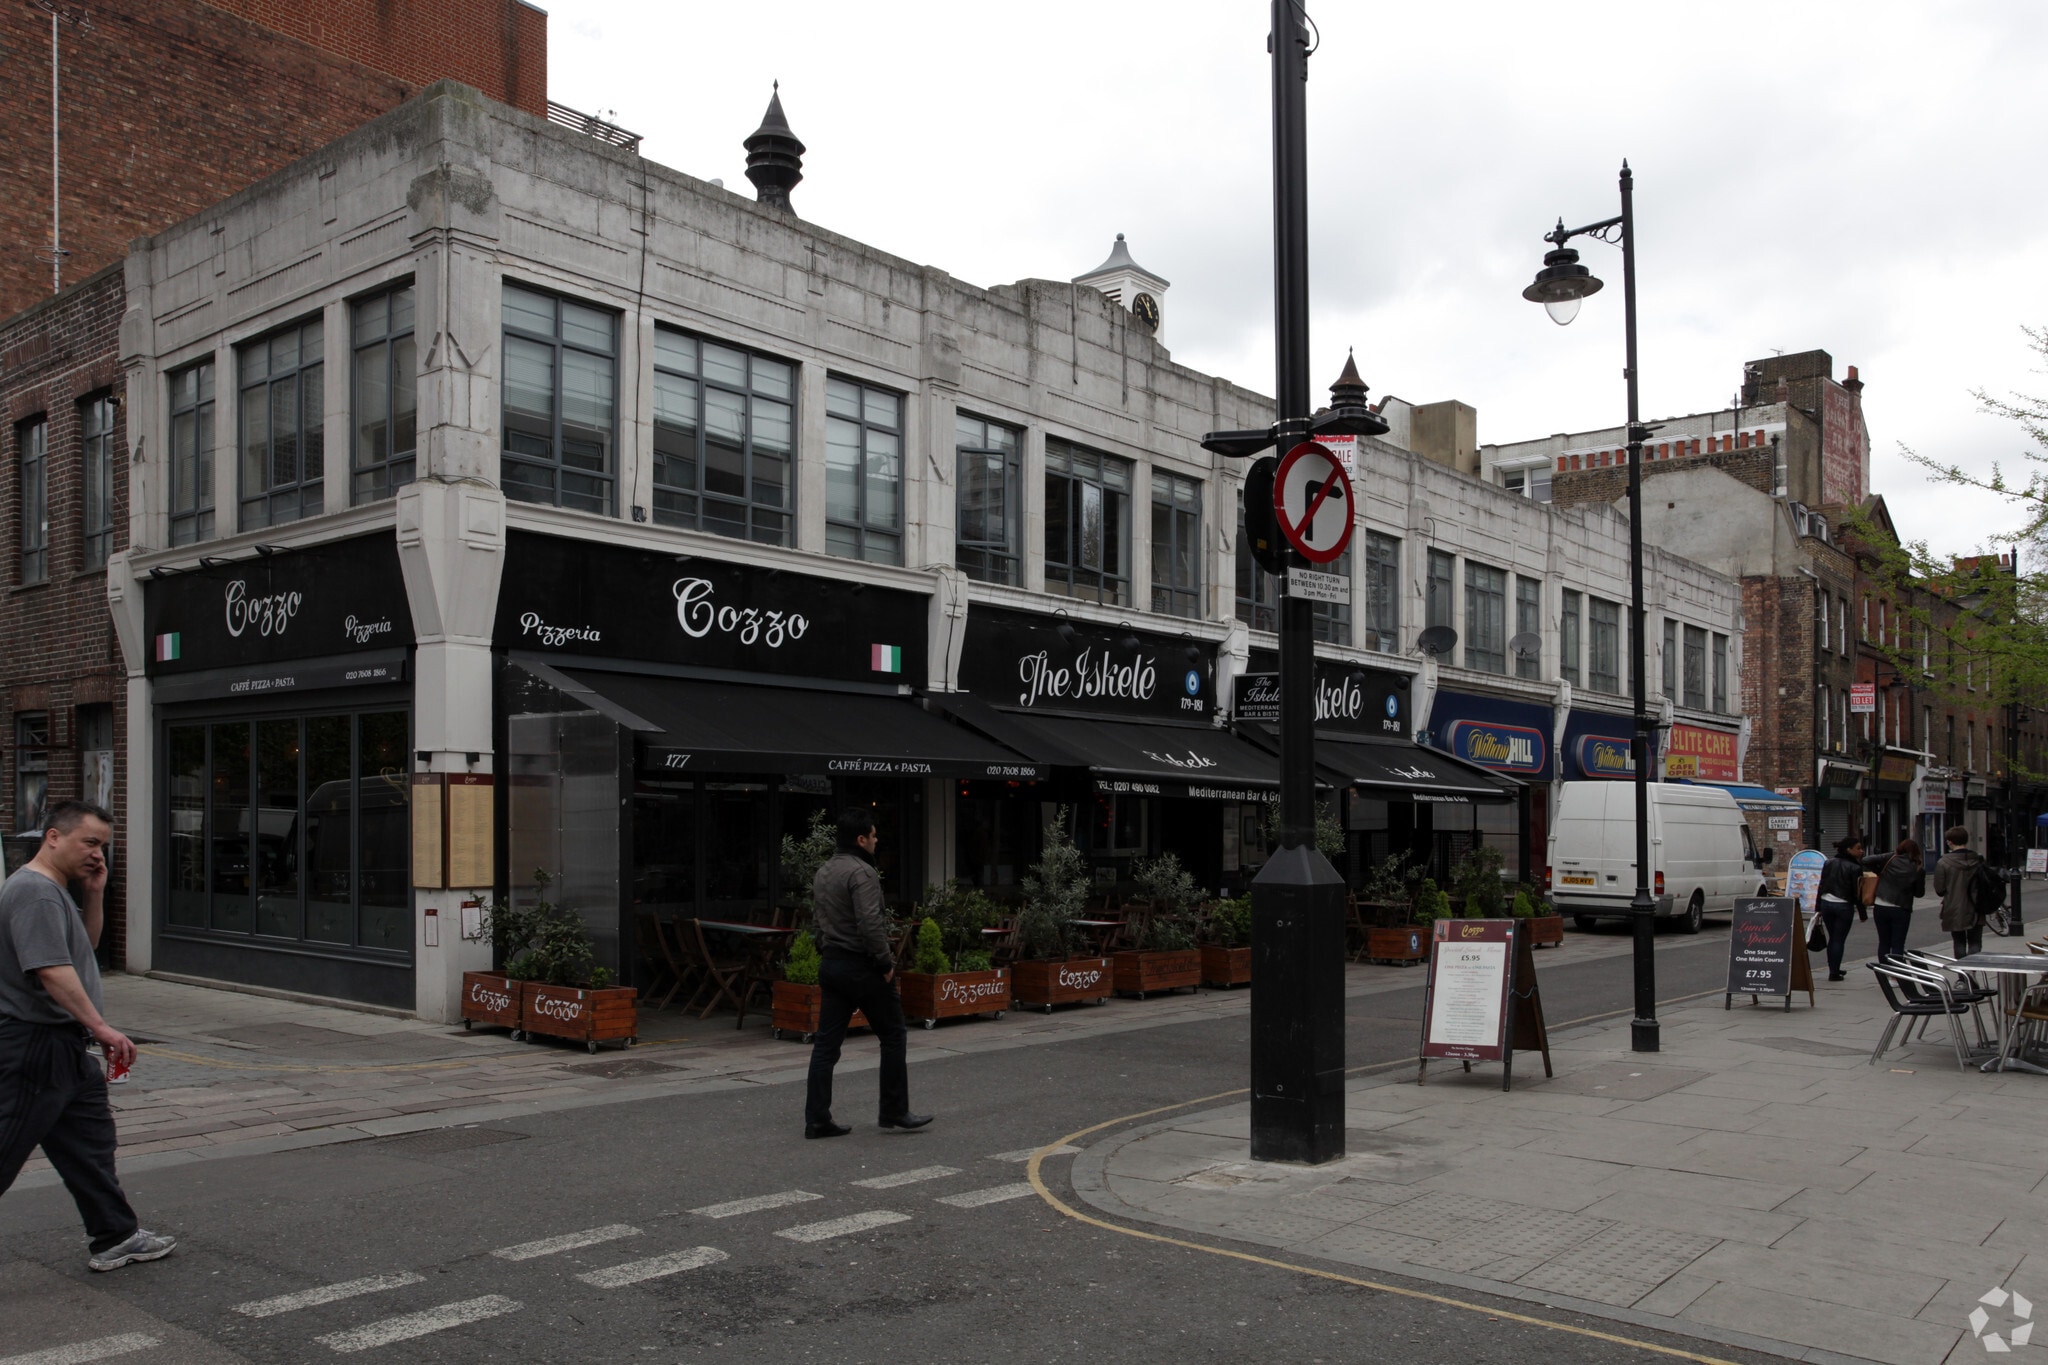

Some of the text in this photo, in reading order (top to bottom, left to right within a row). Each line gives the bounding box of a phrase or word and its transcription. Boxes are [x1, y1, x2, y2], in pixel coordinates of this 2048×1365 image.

[1290, 578, 1317, 589] BETWEEN
[1317, 583, 1331, 591] 10.30
[1299, 571, 1340, 584] NO RIGHT TURN
[1303, 588, 1308, 596] 3
[225, 580, 302, 638] Cozzo
[672, 577, 809, 648] Cozzo
[345, 614, 392, 644] Pizzeria
[520, 612, 601, 646] Pizzeria
[345, 668, 387, 680] 020 7608 1866
[1018, 646, 1157, 707] The Iskelé
[1255, 676, 1272, 687] The
[230, 679, 250, 692] CAFFÉ
[251, 678, 271, 690] PIZZA
[275, 677, 295, 688] PASTA
[1180, 697, 1203, 711] 179-181
[1314, 676, 1364, 721] skelé
[1852, 696, 1873, 705] TO LET
[1467, 729, 1533, 763] William HILL
[1673, 729, 1731, 756] ELITE CAFE
[664, 753, 690, 768] 177
[1593, 742, 1625, 769] William
[828, 758, 861, 771] CAFFÉ
[863, 762, 892, 772] PIZZA
[901, 763, 932, 773] PASTA
[987, 766, 1036, 776] 020 7608 1866
[1096, 780, 1113, 791] TEL:
[1113, 781, 1130, 792] 0207
[1131, 783, 1145, 793] 490
[1189, 785, 1281, 802] Mediterranean Bar & Gri
[1412, 793, 1446, 802] Mediterranean
[1461, 925, 1484, 938] Cozzo
[1737, 921, 1771, 934] Lunch
[1742, 932, 1787, 947] Special
[1059, 965, 1102, 989] Cozzo
[1745, 970, 1772, 978] £7.95
[471, 983, 511, 1012] Cozzo
[940, 979, 1005, 1004] Pizzeria
[535, 989, 582, 1021] Cozzo
